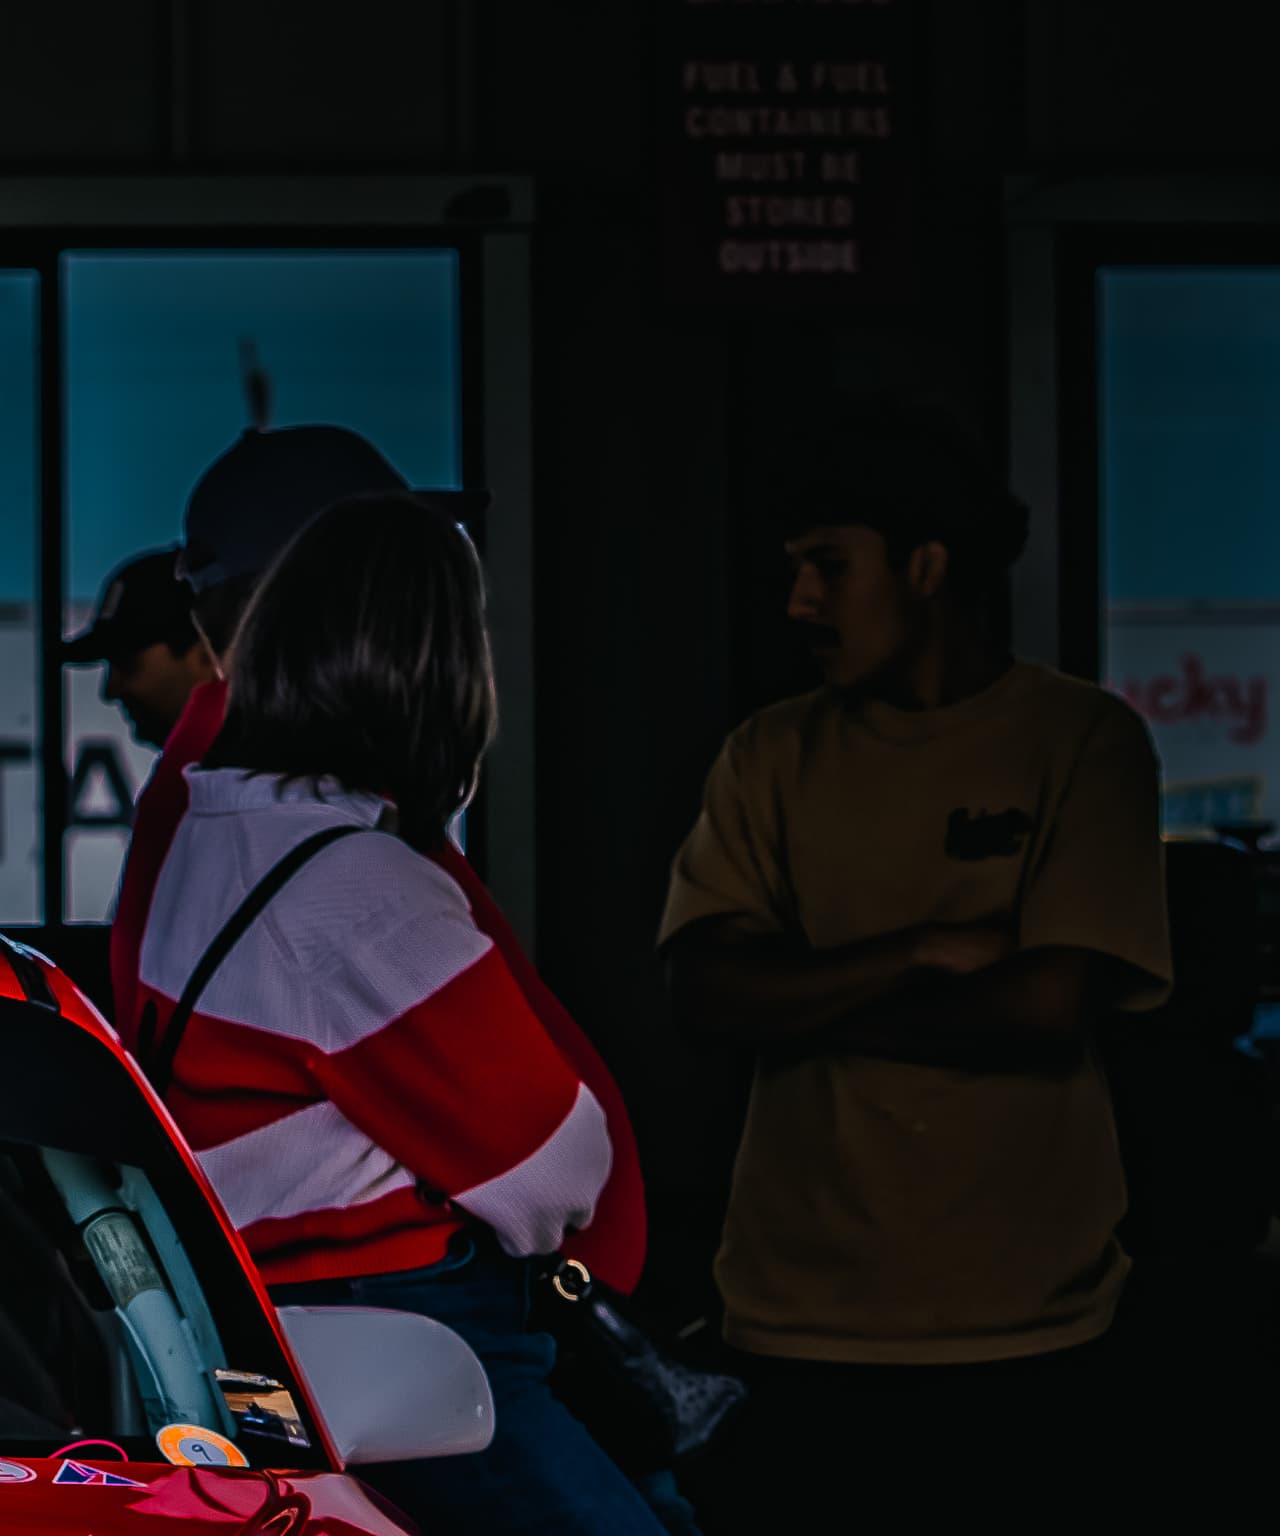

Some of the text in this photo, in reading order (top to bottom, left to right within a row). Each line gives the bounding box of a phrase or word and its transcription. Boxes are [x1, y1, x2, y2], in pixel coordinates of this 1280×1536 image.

[682, 60, 892, 96] FUEL & FUEL
[684, 106, 891, 138] CONTAINERS
[715, 151, 862, 182] MUST BE
[724, 195, 854, 227] STORED
[718, 240, 859, 273] OUTSIDE
